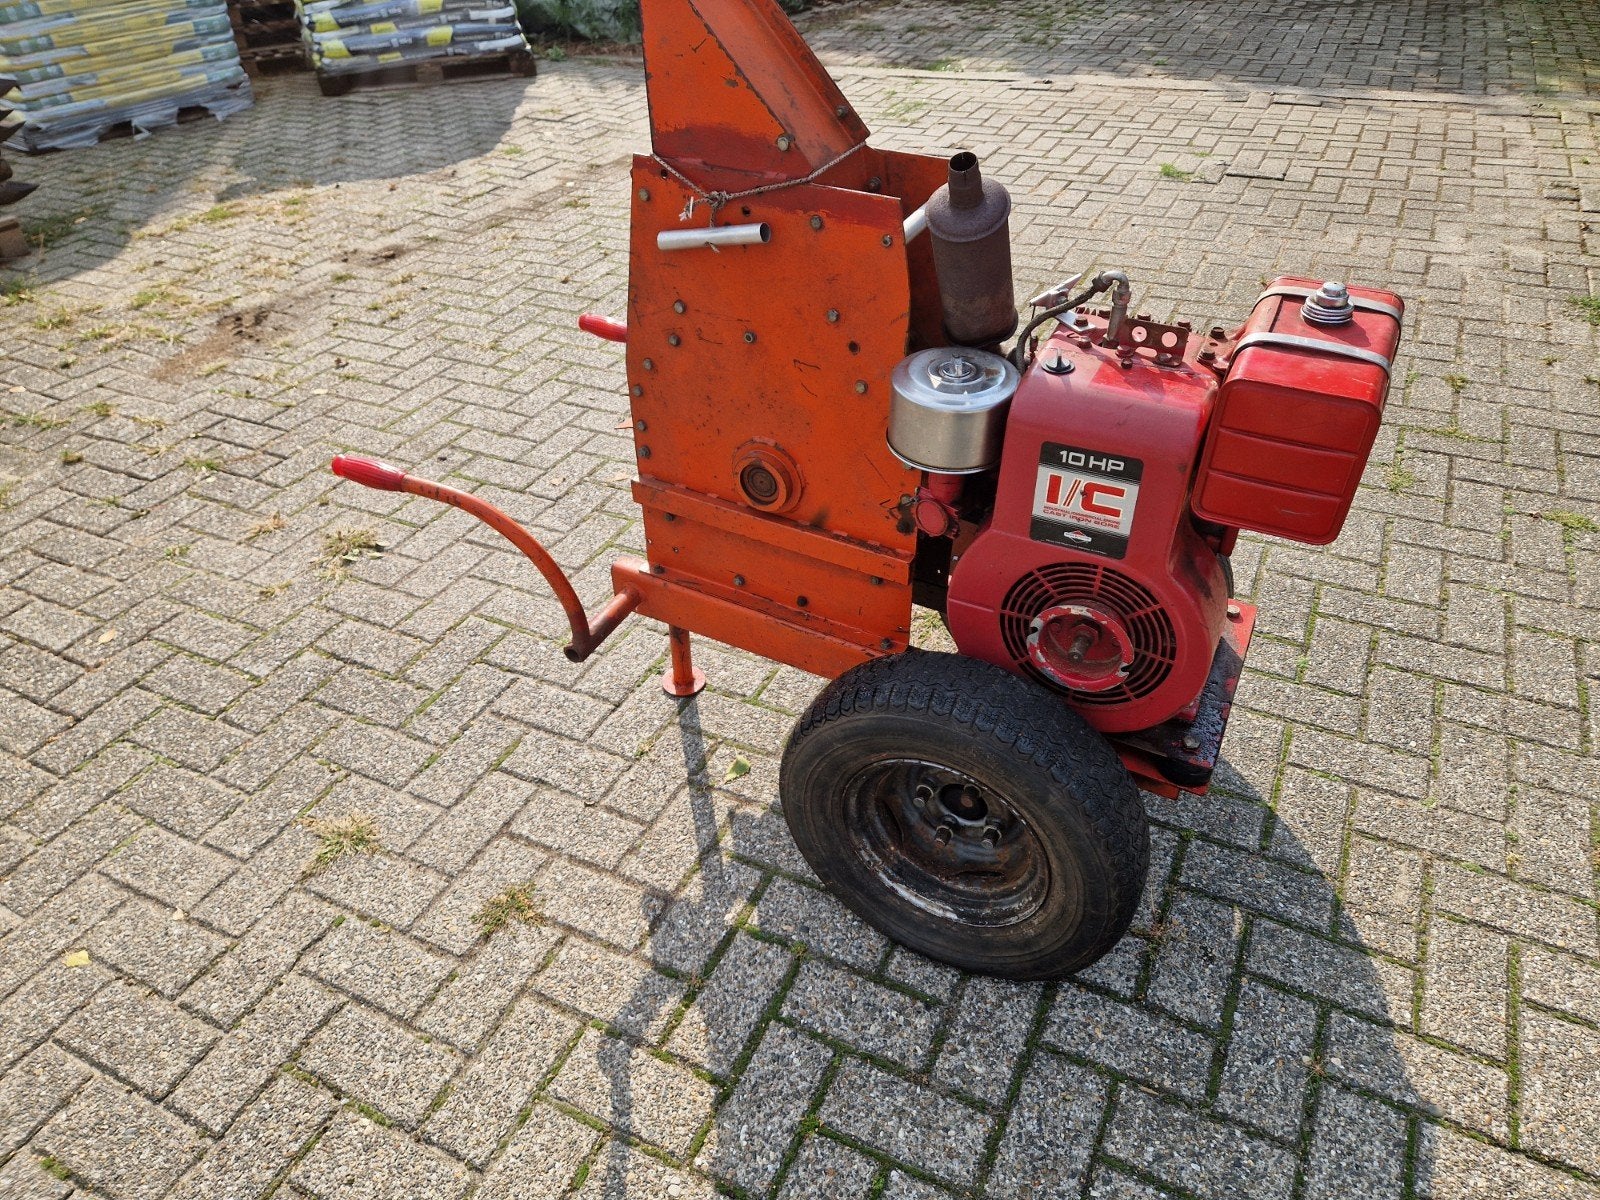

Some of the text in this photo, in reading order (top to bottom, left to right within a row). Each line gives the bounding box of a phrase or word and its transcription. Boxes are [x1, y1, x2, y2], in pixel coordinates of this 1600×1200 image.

[1060, 450, 1124, 471] 10 HP
[1043, 510, 1120, 529] CAST IRON BORE
